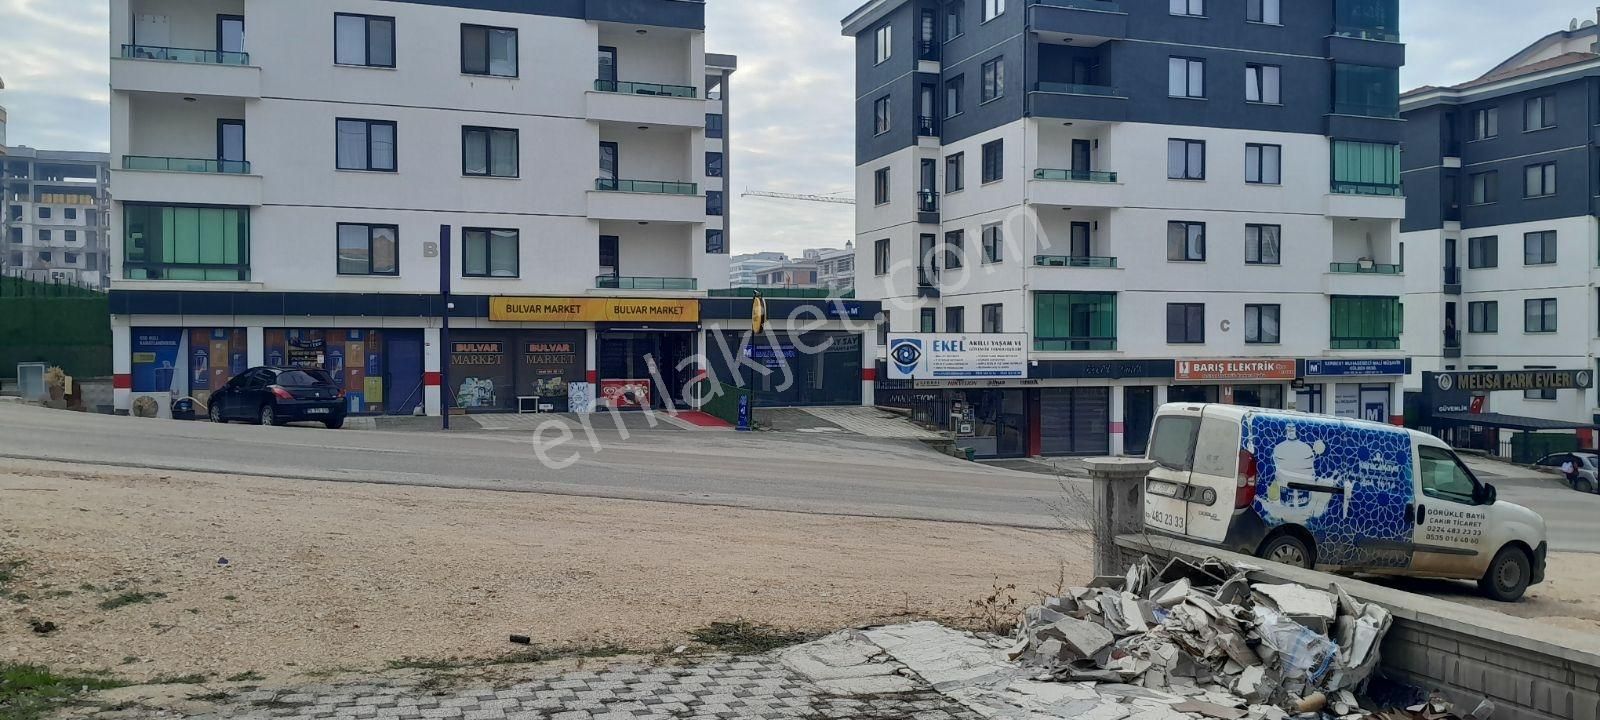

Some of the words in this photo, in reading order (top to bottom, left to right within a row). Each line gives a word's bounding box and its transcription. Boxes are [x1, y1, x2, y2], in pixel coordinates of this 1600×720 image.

[423, 242, 438, 257] B
[505, 304, 542, 314] BULVAR
[543, 304, 582, 315] MARKET
[613, 304, 648, 314] BULVAR
[649, 305, 685, 316] MARKET
[1220, 319, 1231, 332] C
[456, 343, 498, 352] BULVAR
[529, 343, 570, 352] BULVAR
[932, 340, 966, 352] EKEL
[451, 354, 503, 365] MARKET
[526, 354, 576, 365] MARKET
[1193, 363, 1224, 373] BARIŞ
[1227, 361, 1275, 371] ELEKTRİK
[1503, 372, 1534, 388] PARK
[1164, 513, 1173, 526] 23
[1174, 516, 1184, 528] 33
[1427, 525, 1445, 533] 0224
